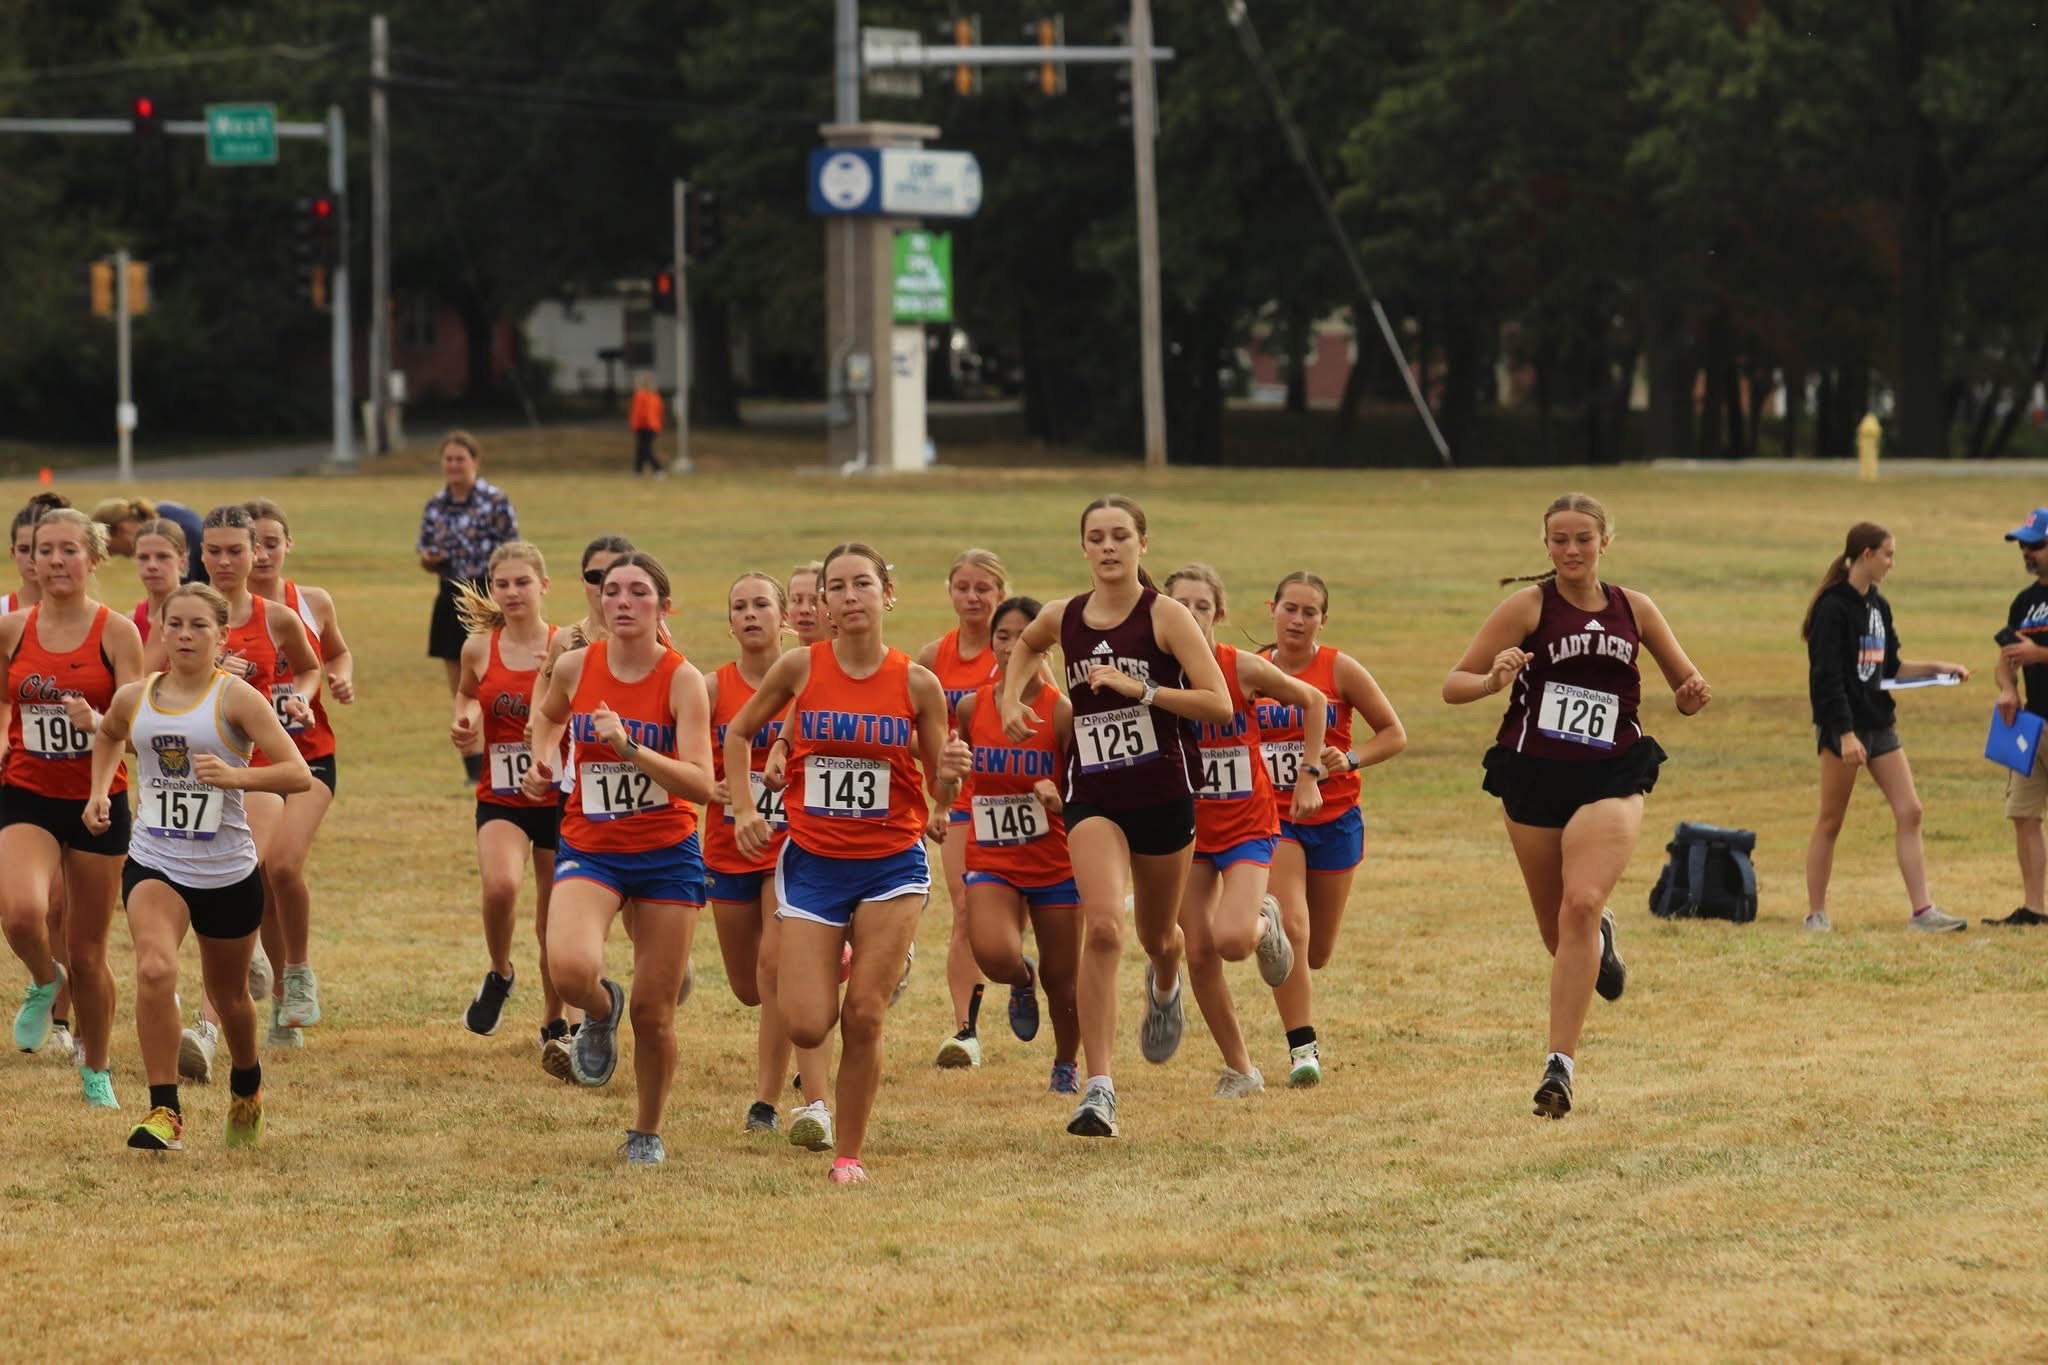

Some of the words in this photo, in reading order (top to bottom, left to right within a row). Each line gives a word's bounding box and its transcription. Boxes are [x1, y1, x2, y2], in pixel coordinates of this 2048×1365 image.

[1548, 633, 1592, 664] LADY
[1596, 633, 1633, 664] ACES
[493, 693, 530, 718] Oln
[1566, 685, 1613, 704] ProRehab
[801, 710, 911, 748] NEWTON
[1091, 709, 1140, 725] ProRehab
[1556, 697, 1607, 738] 126
[34, 716, 89, 752] 196
[151, 734, 187, 749] OPH
[1088, 720, 1144, 762] 125
[827, 758, 880, 770] ProRehab
[971, 747, 1055, 777] EWTON
[1202, 747, 1241, 759] roRehab
[1267, 752, 1304, 785] 13
[162, 779, 213, 792] ProRehab
[502, 753, 532, 787] 19
[1206, 759, 1238, 792] 41
[596, 773, 655, 812] 142
[819, 770, 876, 809] 143
[989, 795, 1034, 807] ProRehab
[156, 791, 209, 831] 157
[986, 804, 1036, 840] 146
